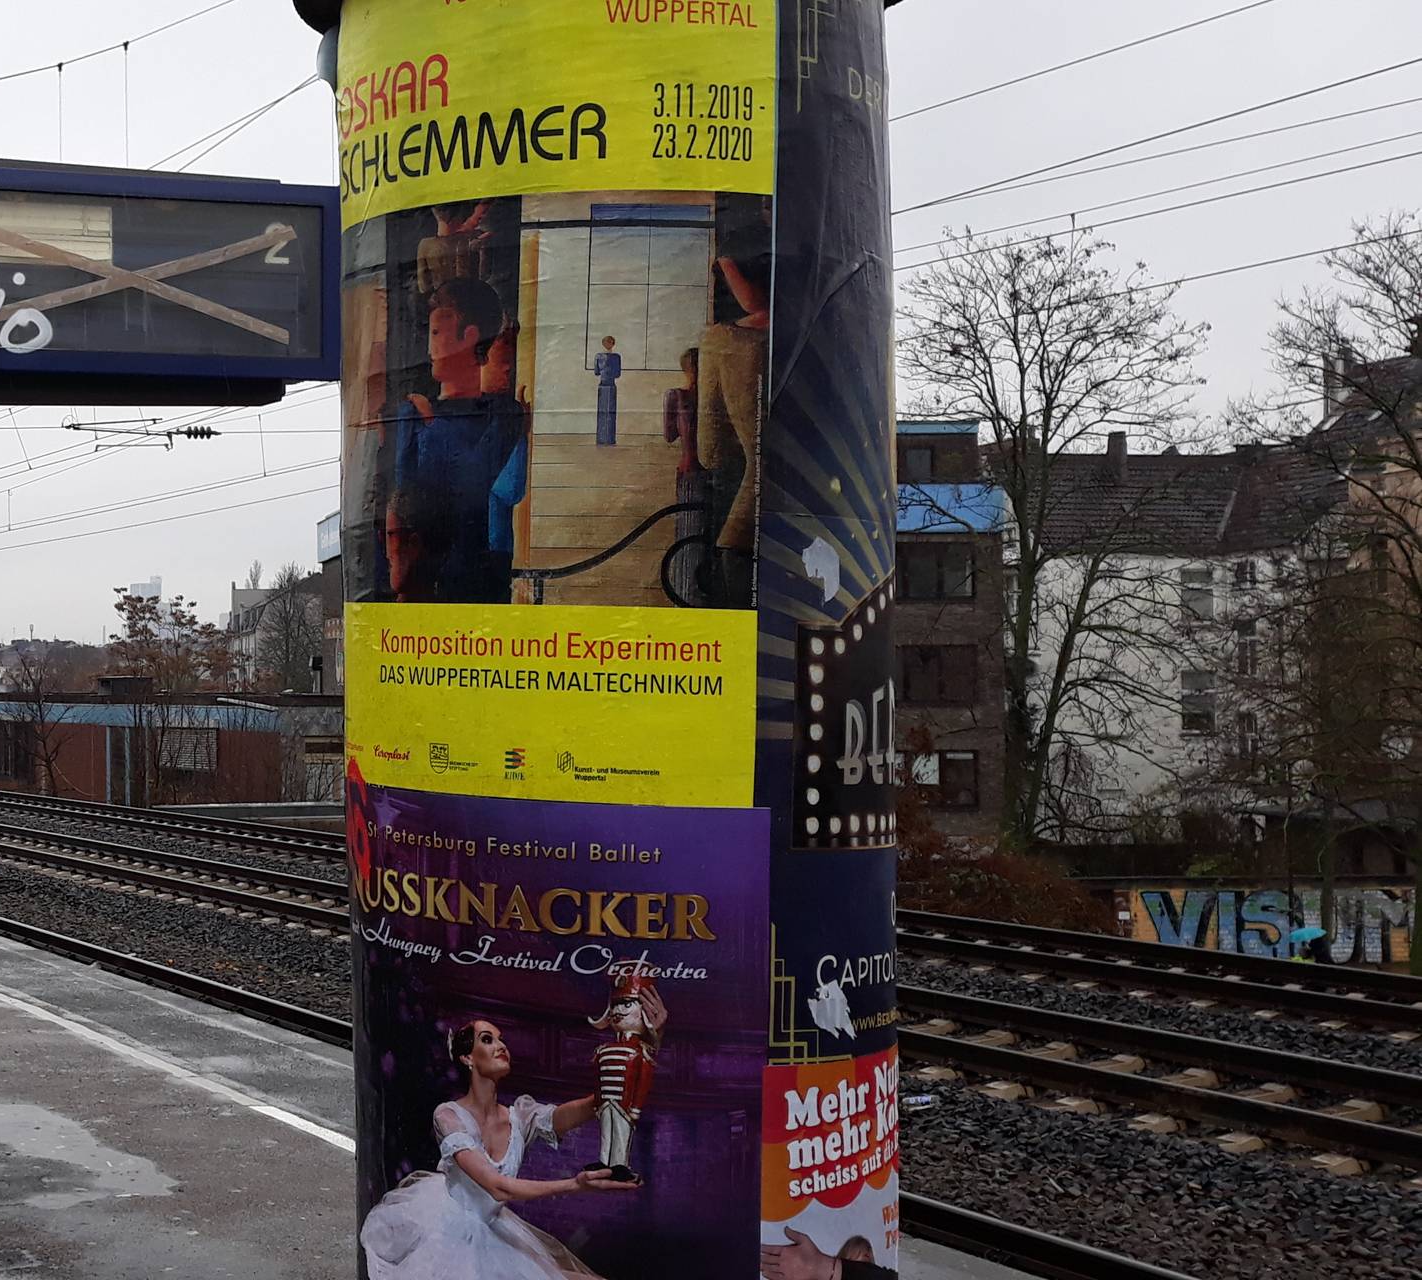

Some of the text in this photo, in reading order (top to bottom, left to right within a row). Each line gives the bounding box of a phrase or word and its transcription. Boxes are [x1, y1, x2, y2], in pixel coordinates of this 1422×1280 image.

[606, 0, 758, 28] WUPPERTAL
[339, 53, 450, 140] OSKAR
[653, 83, 753, 121] 3.11.2019
[341, 102, 607, 202] SCHLEMMER
[652, 124, 753, 162] 23.2.2020
[381, 628, 503, 660] Komposition
[511, 632, 558, 658] und
[567, 632, 722, 666] Experiment
[380, 664, 723, 696] DAS WUPPERTALER MALTECHNIKUM
[574, 774, 606, 783] Wuppertal
[610, 768, 660, 777] Museumsverein
[384, 825, 477, 857] Petersburg
[487, 837, 576, 861] Festival
[589, 843, 662, 864] Ballet
[361, 916, 442, 963] Hungary
[449, 935, 564, 972] Festival
[570, 944, 708, 979] Orchestra
[784, 1078, 870, 1131] Mehr
[787, 1117, 871, 1170] mehr
[788, 1163, 859, 1198] scheiss
[862, 1146, 882, 1177] auf
